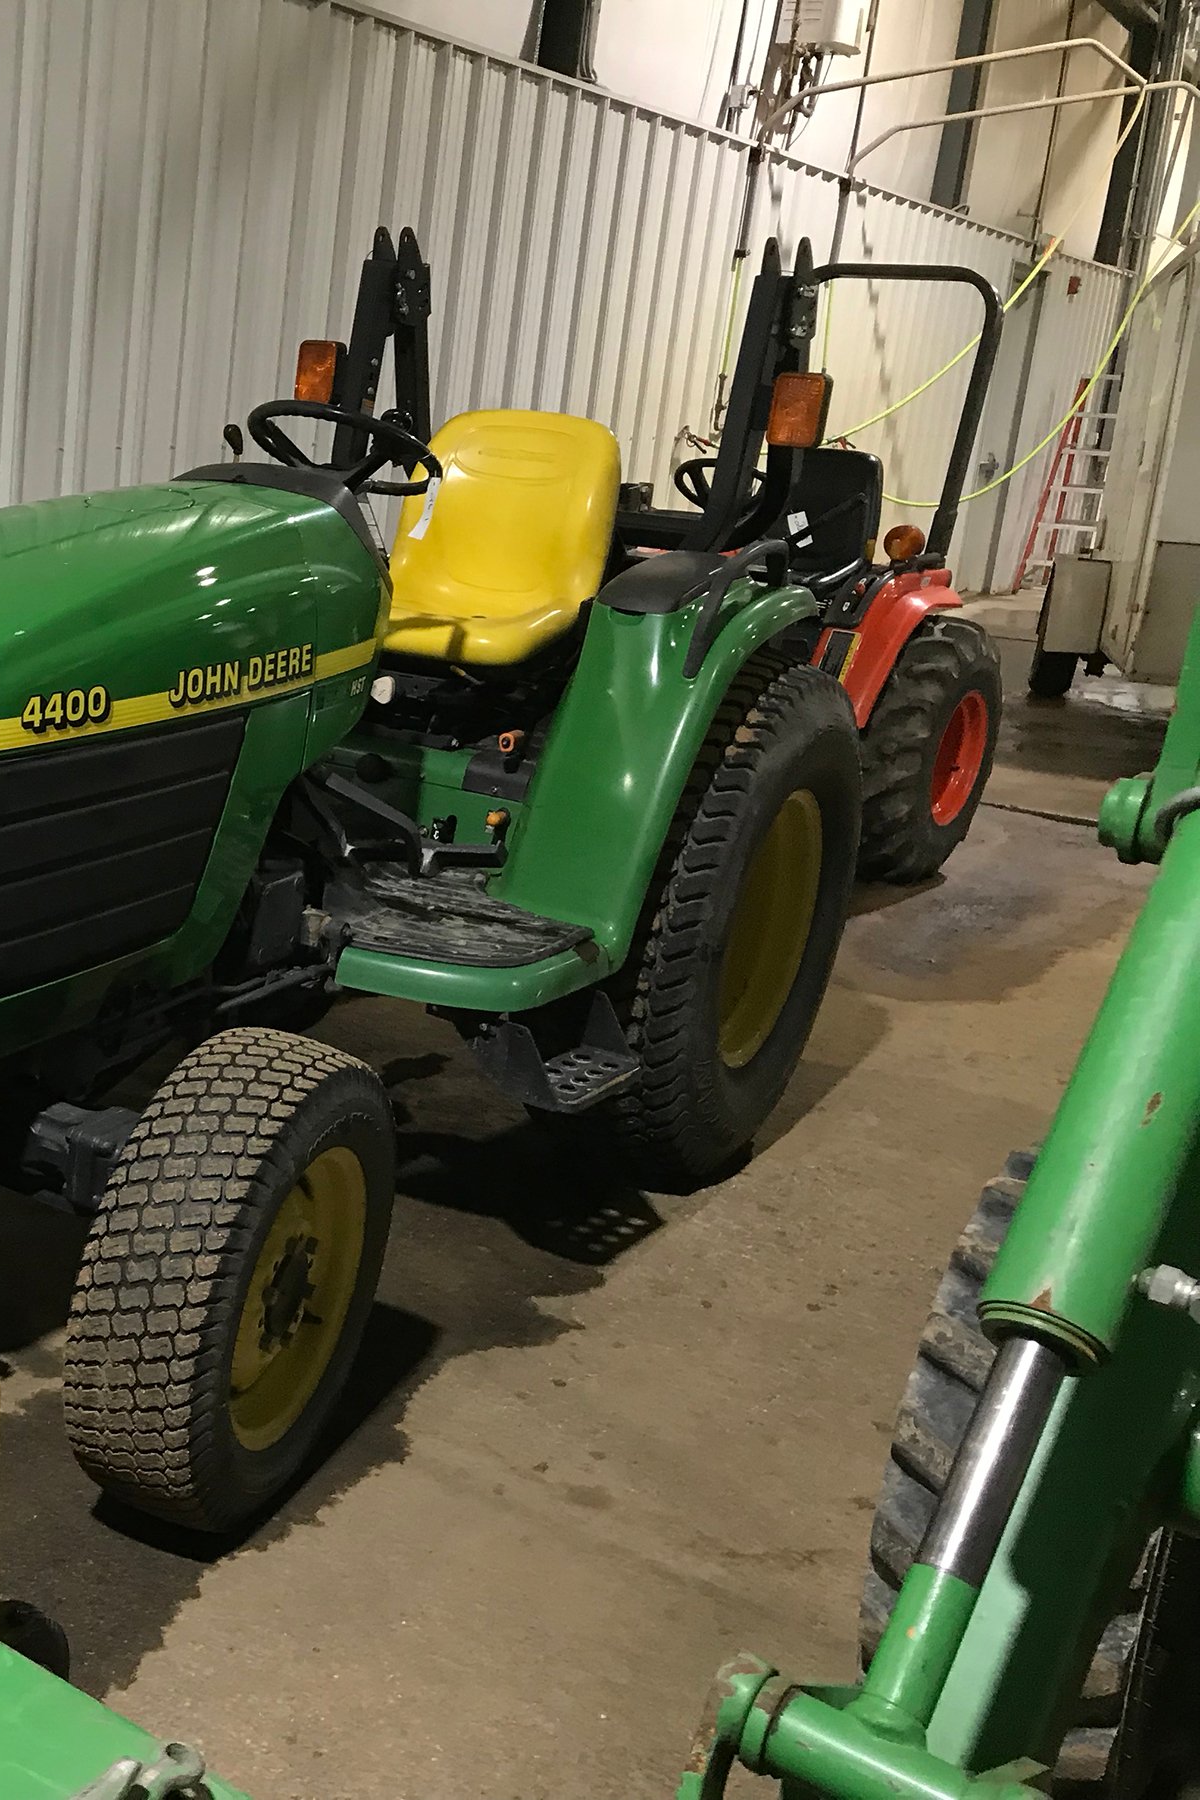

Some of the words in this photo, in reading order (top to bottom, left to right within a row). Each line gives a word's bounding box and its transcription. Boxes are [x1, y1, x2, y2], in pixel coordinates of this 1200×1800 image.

[169, 663, 244, 708] JOHN
[246, 643, 314, 687] DEERE
[22, 686, 109, 731] 4400
